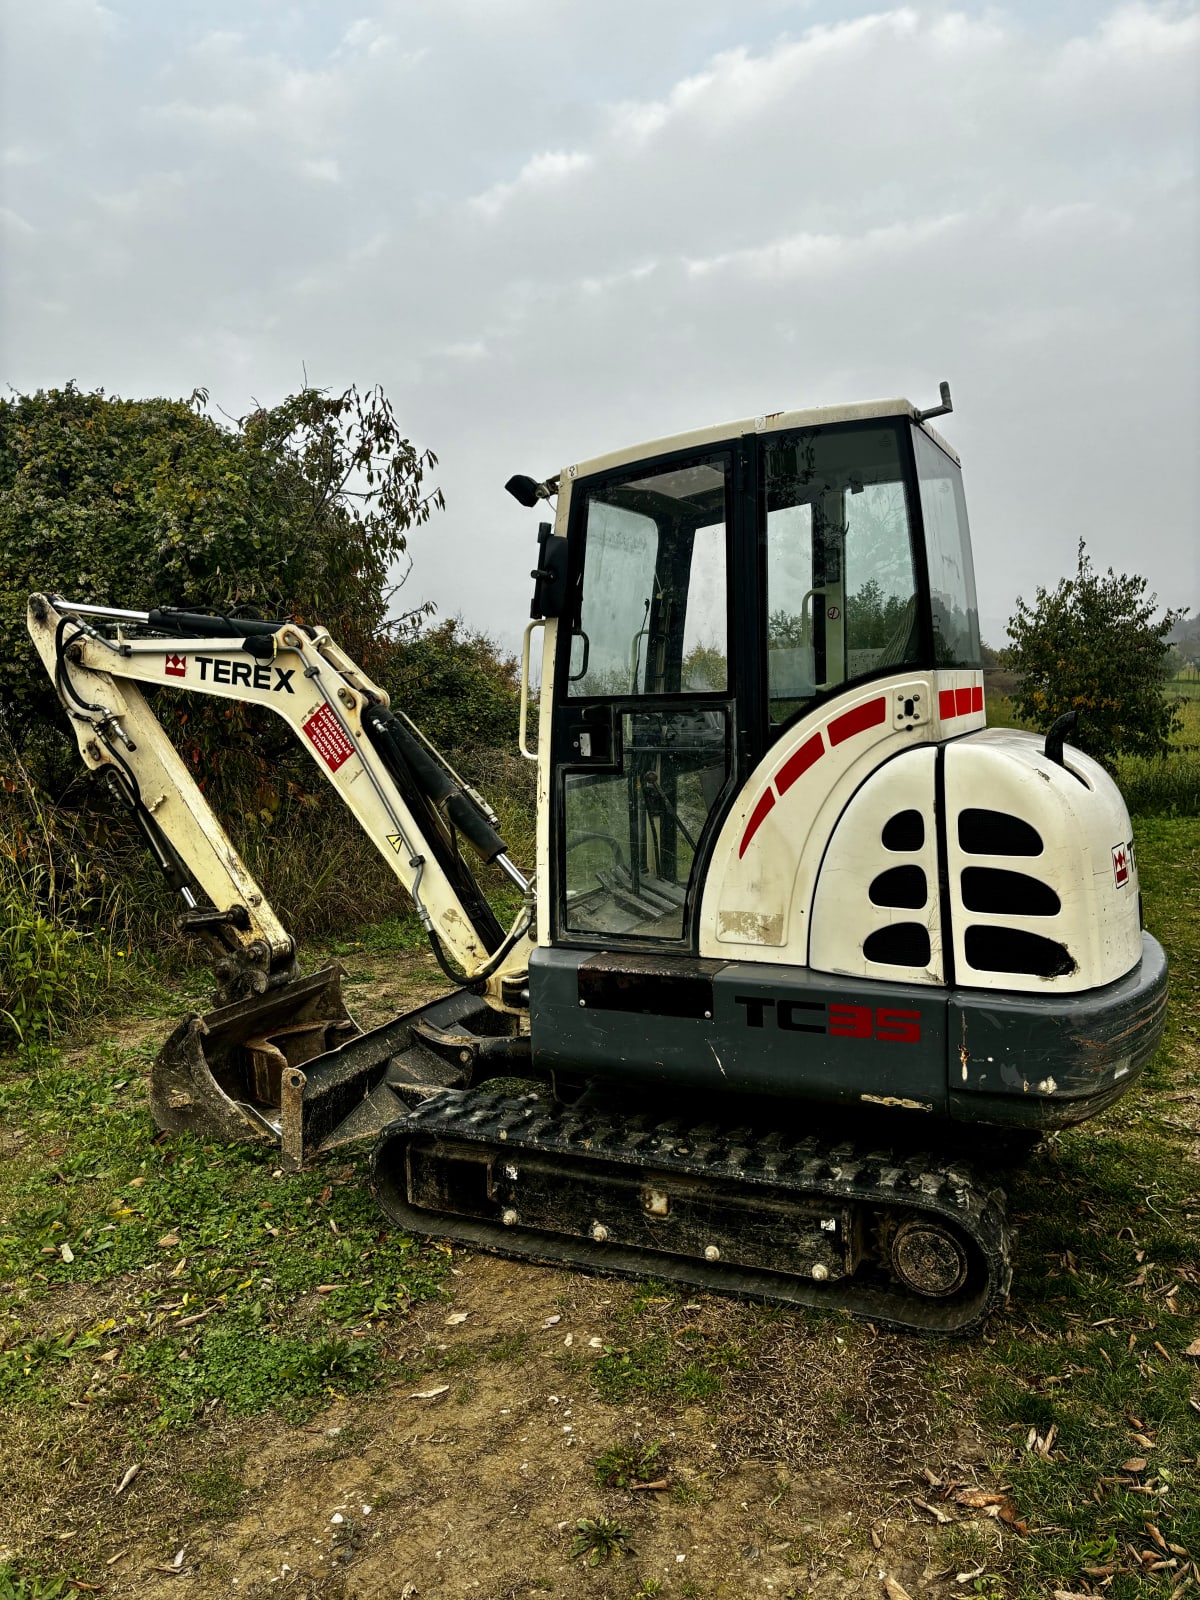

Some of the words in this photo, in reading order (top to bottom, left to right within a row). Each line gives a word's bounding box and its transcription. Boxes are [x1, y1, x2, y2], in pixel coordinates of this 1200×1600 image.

[195, 656, 296, 694] TEREX
[310, 721, 340, 763] DJELOKRUGU
[311, 734, 330, 760] STROJA
[322, 727, 342, 754] RADNOM
[735, 996, 921, 1043] TC35
